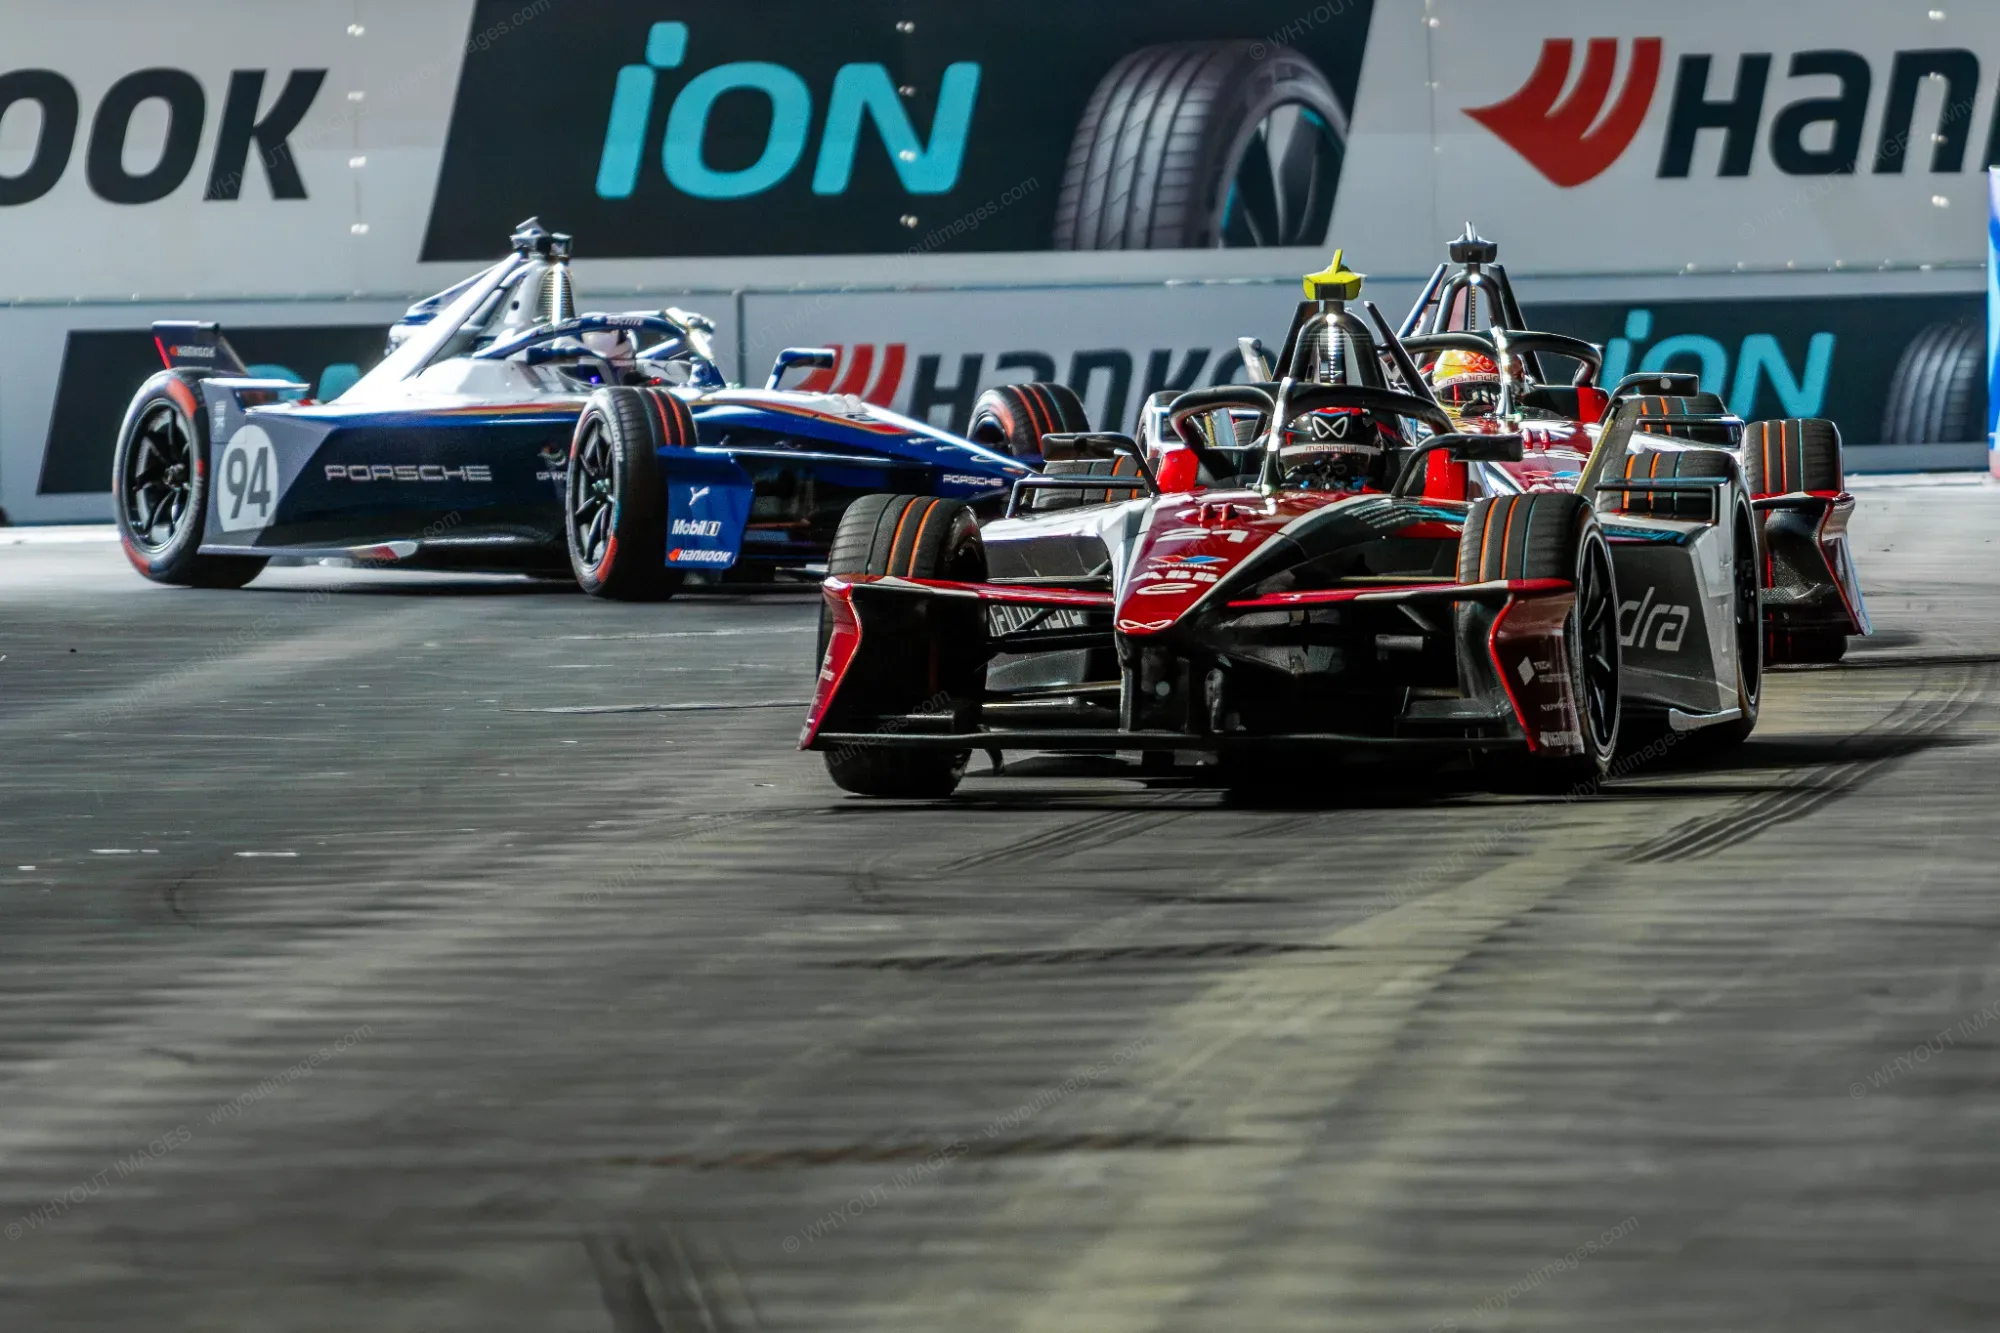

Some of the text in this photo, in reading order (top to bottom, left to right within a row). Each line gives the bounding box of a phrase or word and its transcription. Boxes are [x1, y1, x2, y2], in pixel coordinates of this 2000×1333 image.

[595, 21, 981, 199] iON
[1655, 48, 2000, 178] Han
[0, 67, 329, 205] OOK
[226, 447, 271, 520] 94
[325, 465, 492, 481] PORSCHE
[943, 475, 1003, 487] PORSCHE
[672, 519, 705, 536] Mobil
[1131, 570, 1219, 582] ABB
